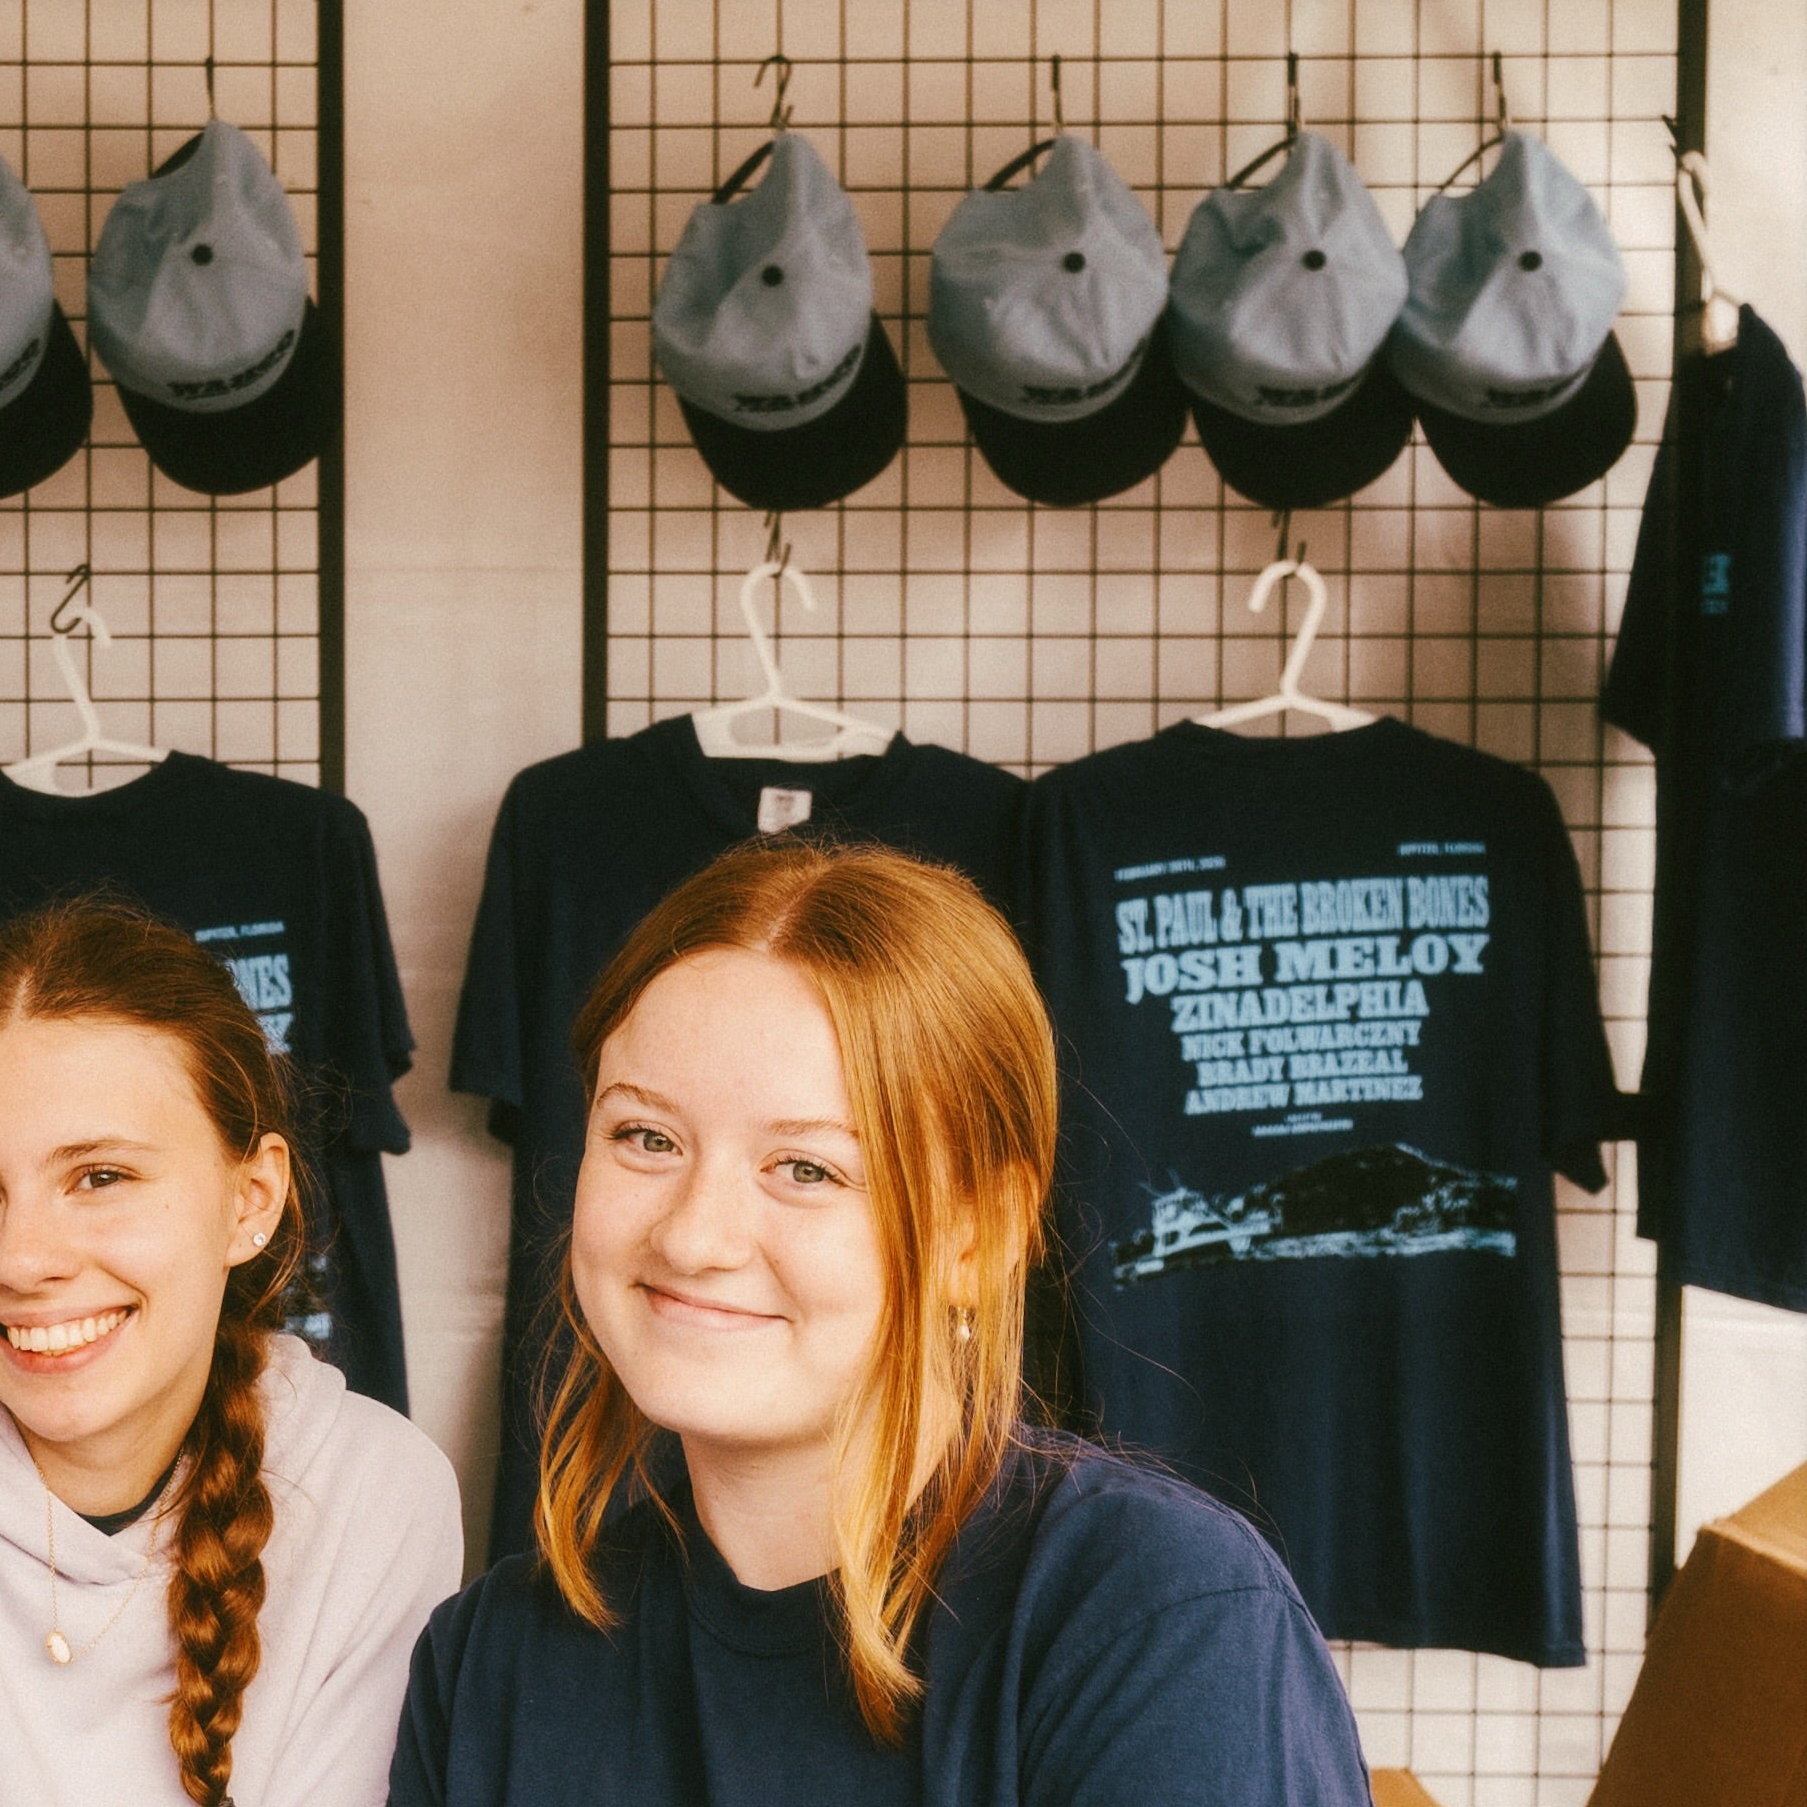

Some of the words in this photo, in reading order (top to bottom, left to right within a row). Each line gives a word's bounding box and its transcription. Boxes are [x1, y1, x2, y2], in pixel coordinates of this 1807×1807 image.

[1153, 889, 1218, 949] PAUL
[1220, 887, 1243, 942] &
[1243, 882, 1297, 940] THE
[1300, 877, 1404, 935] BROKEN
[1406, 875, 1490, 930] BONES
[1120, 946, 1263, 1004] JOSH
[1273, 933, 1490, 983] MELOY
[1171, 980, 1430, 1033] ZINADELPHIA
